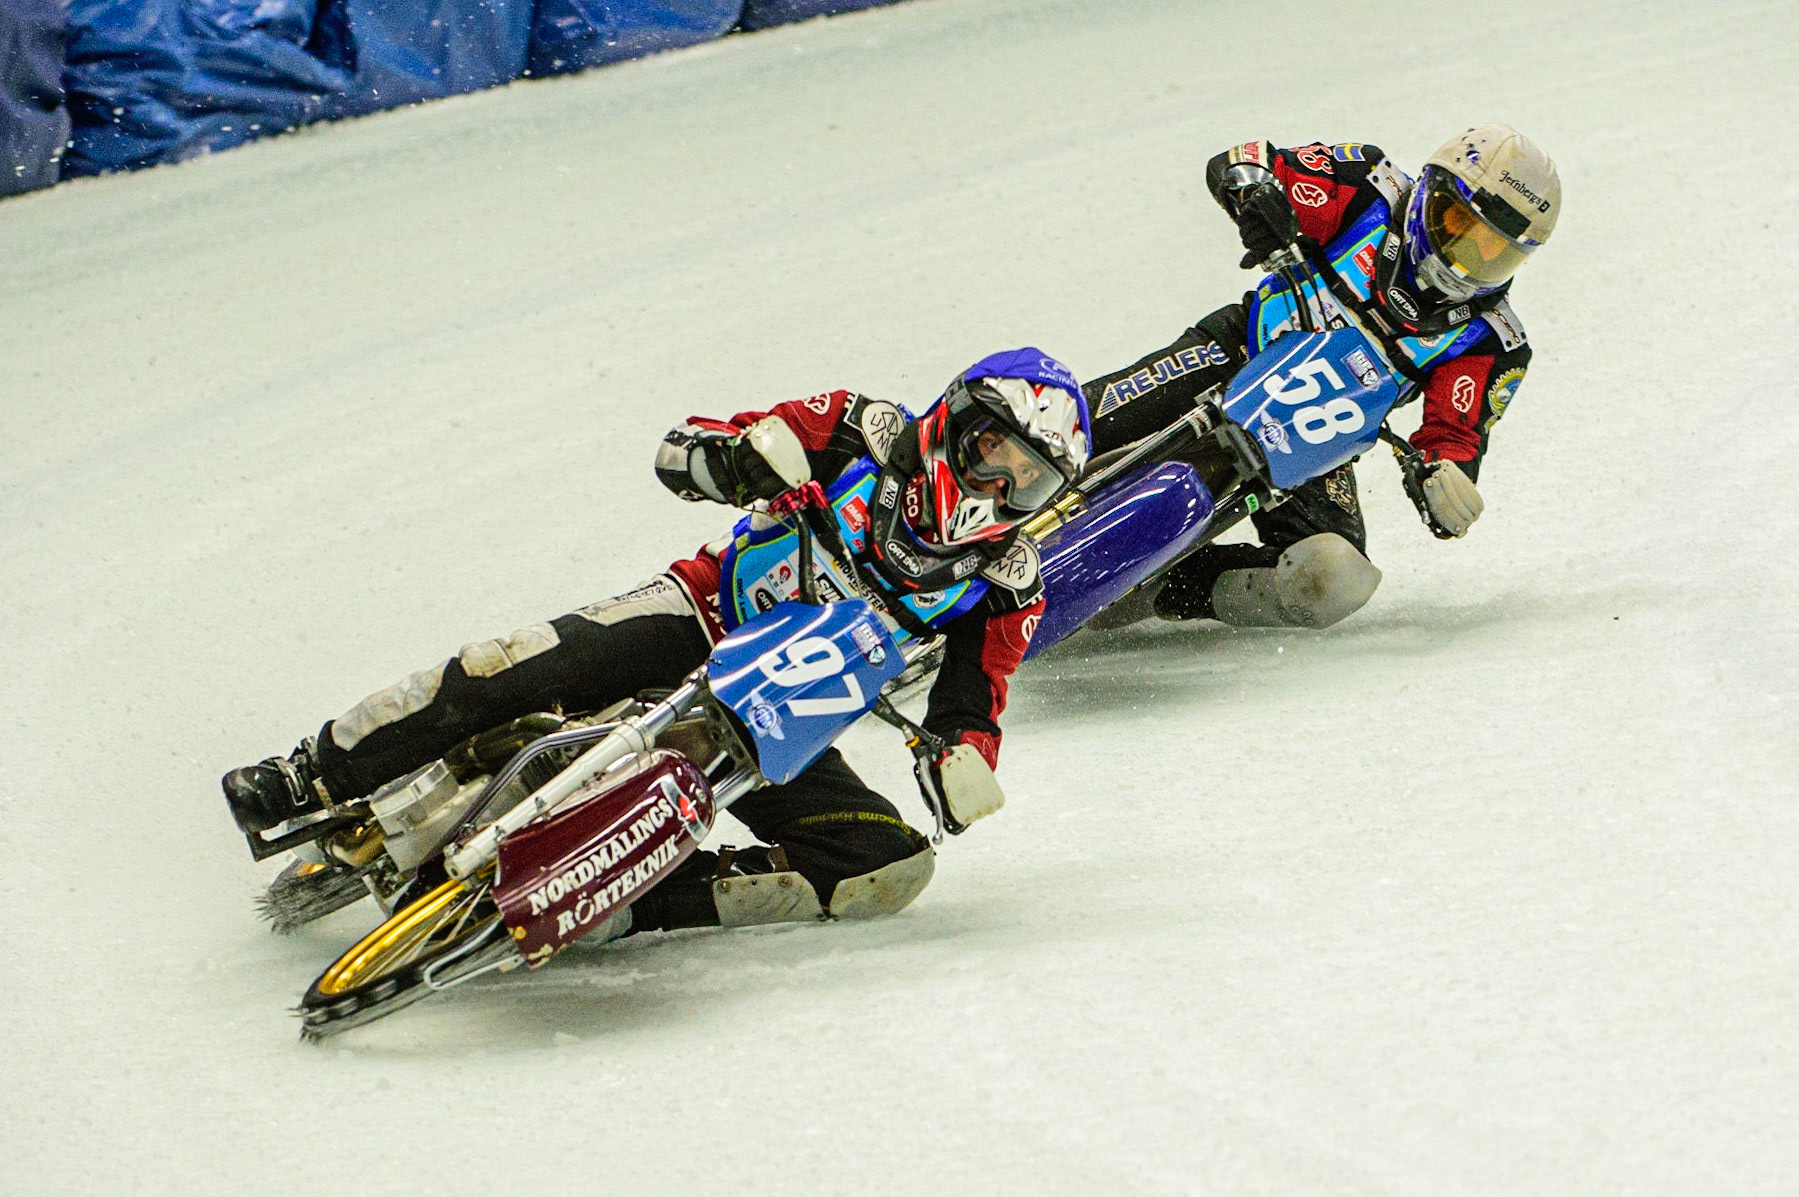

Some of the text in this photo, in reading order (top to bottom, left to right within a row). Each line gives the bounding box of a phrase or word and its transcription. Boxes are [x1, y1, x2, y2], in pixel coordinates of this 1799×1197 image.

[1389, 289, 1419, 319] ORTEMA
[1038, 371, 1077, 390] RACING
[1114, 340, 1231, 402] REJLERS
[1263, 357, 1367, 445] 58
[888, 543, 920, 575] ORTEMA
[757, 635, 866, 718] 97
[526, 797, 675, 917] NORDMALINGS
[555, 833, 680, 938] RÖRTEKNIK
